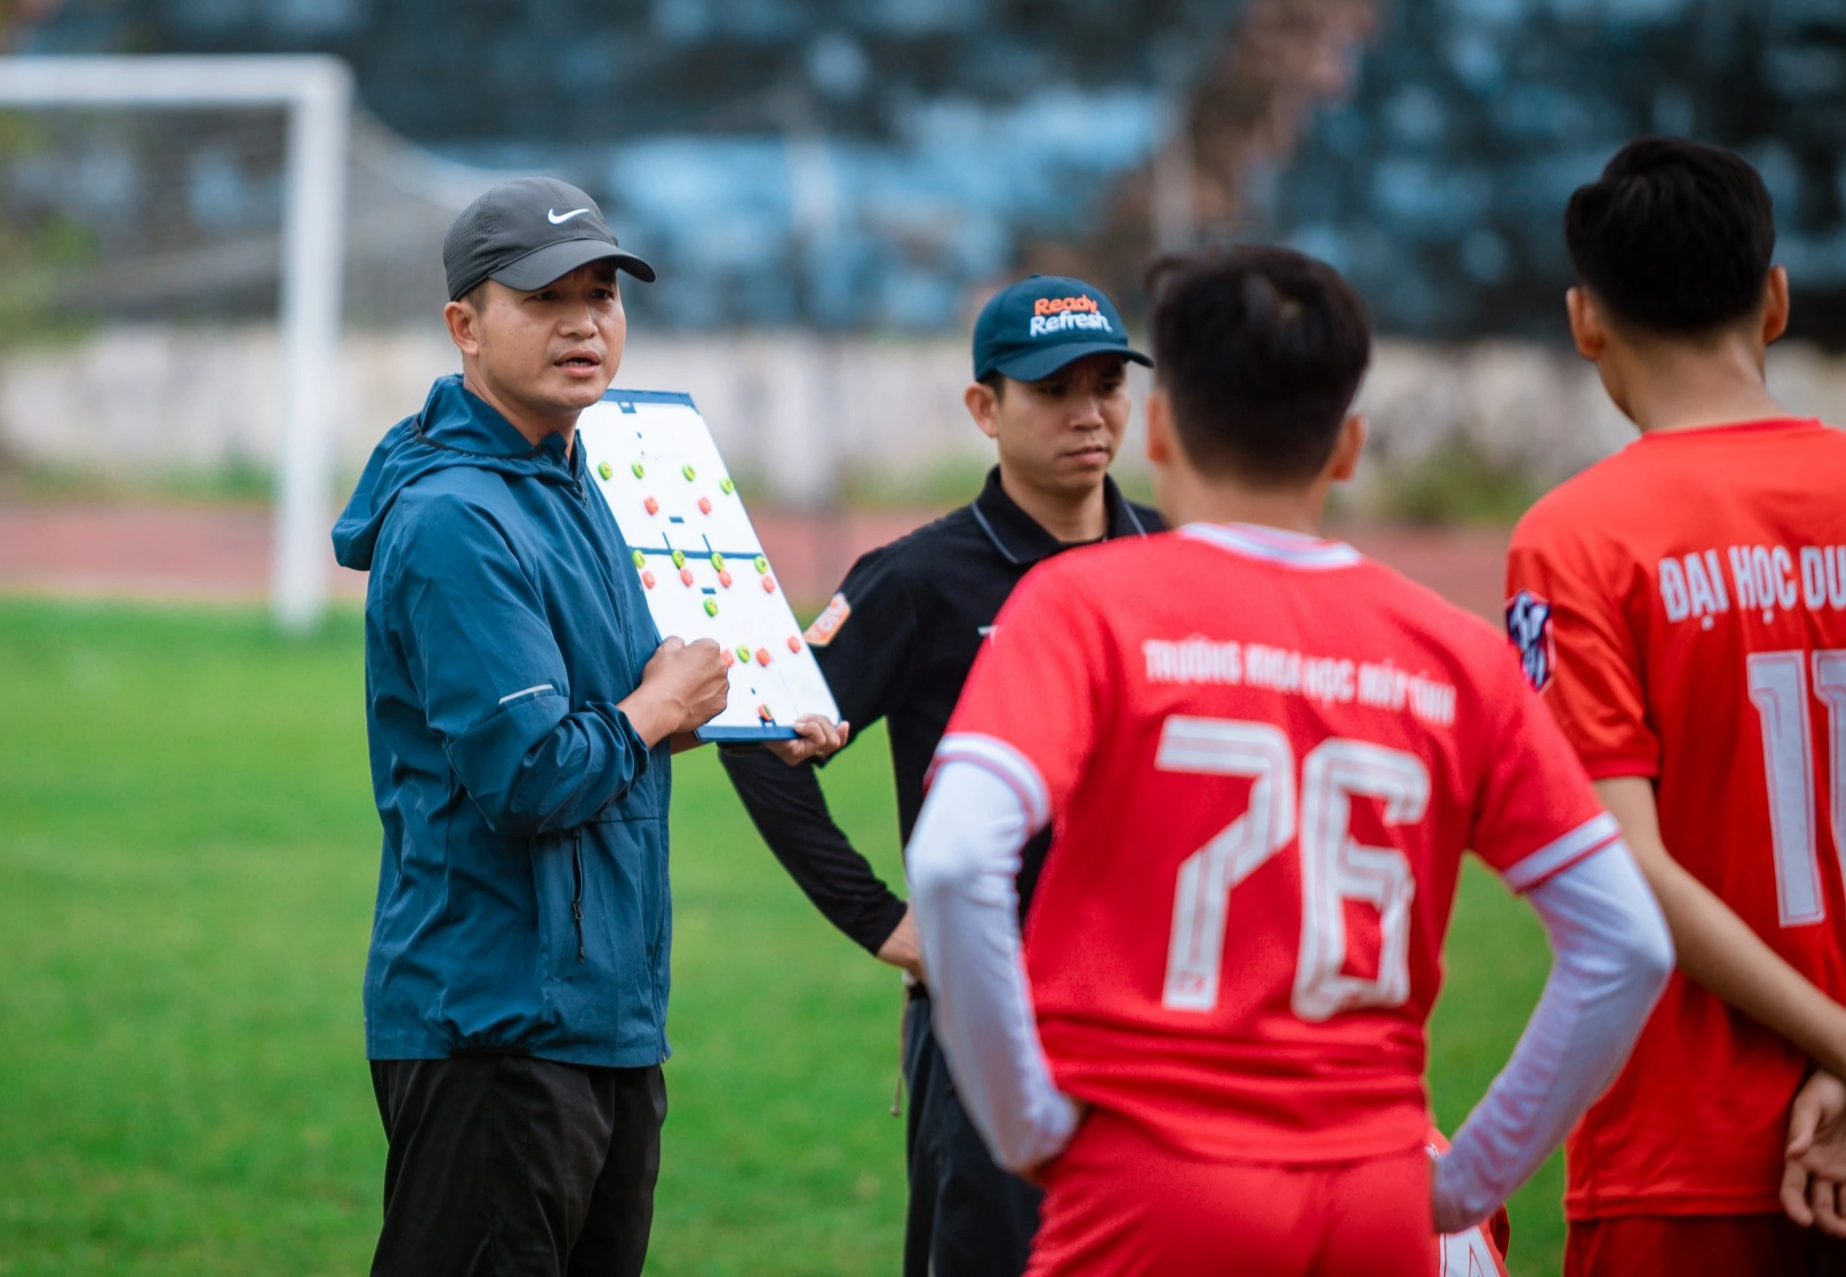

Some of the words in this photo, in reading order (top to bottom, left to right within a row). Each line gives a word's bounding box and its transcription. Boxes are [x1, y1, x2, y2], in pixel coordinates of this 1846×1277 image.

[1029, 310, 1113, 338] Refresh
[1034, 294, 1098, 316] Ready
[1658, 548, 1730, 631] ĐẠI
[1727, 544, 1797, 625] HỌC
[1154, 714, 1431, 1021] 76
